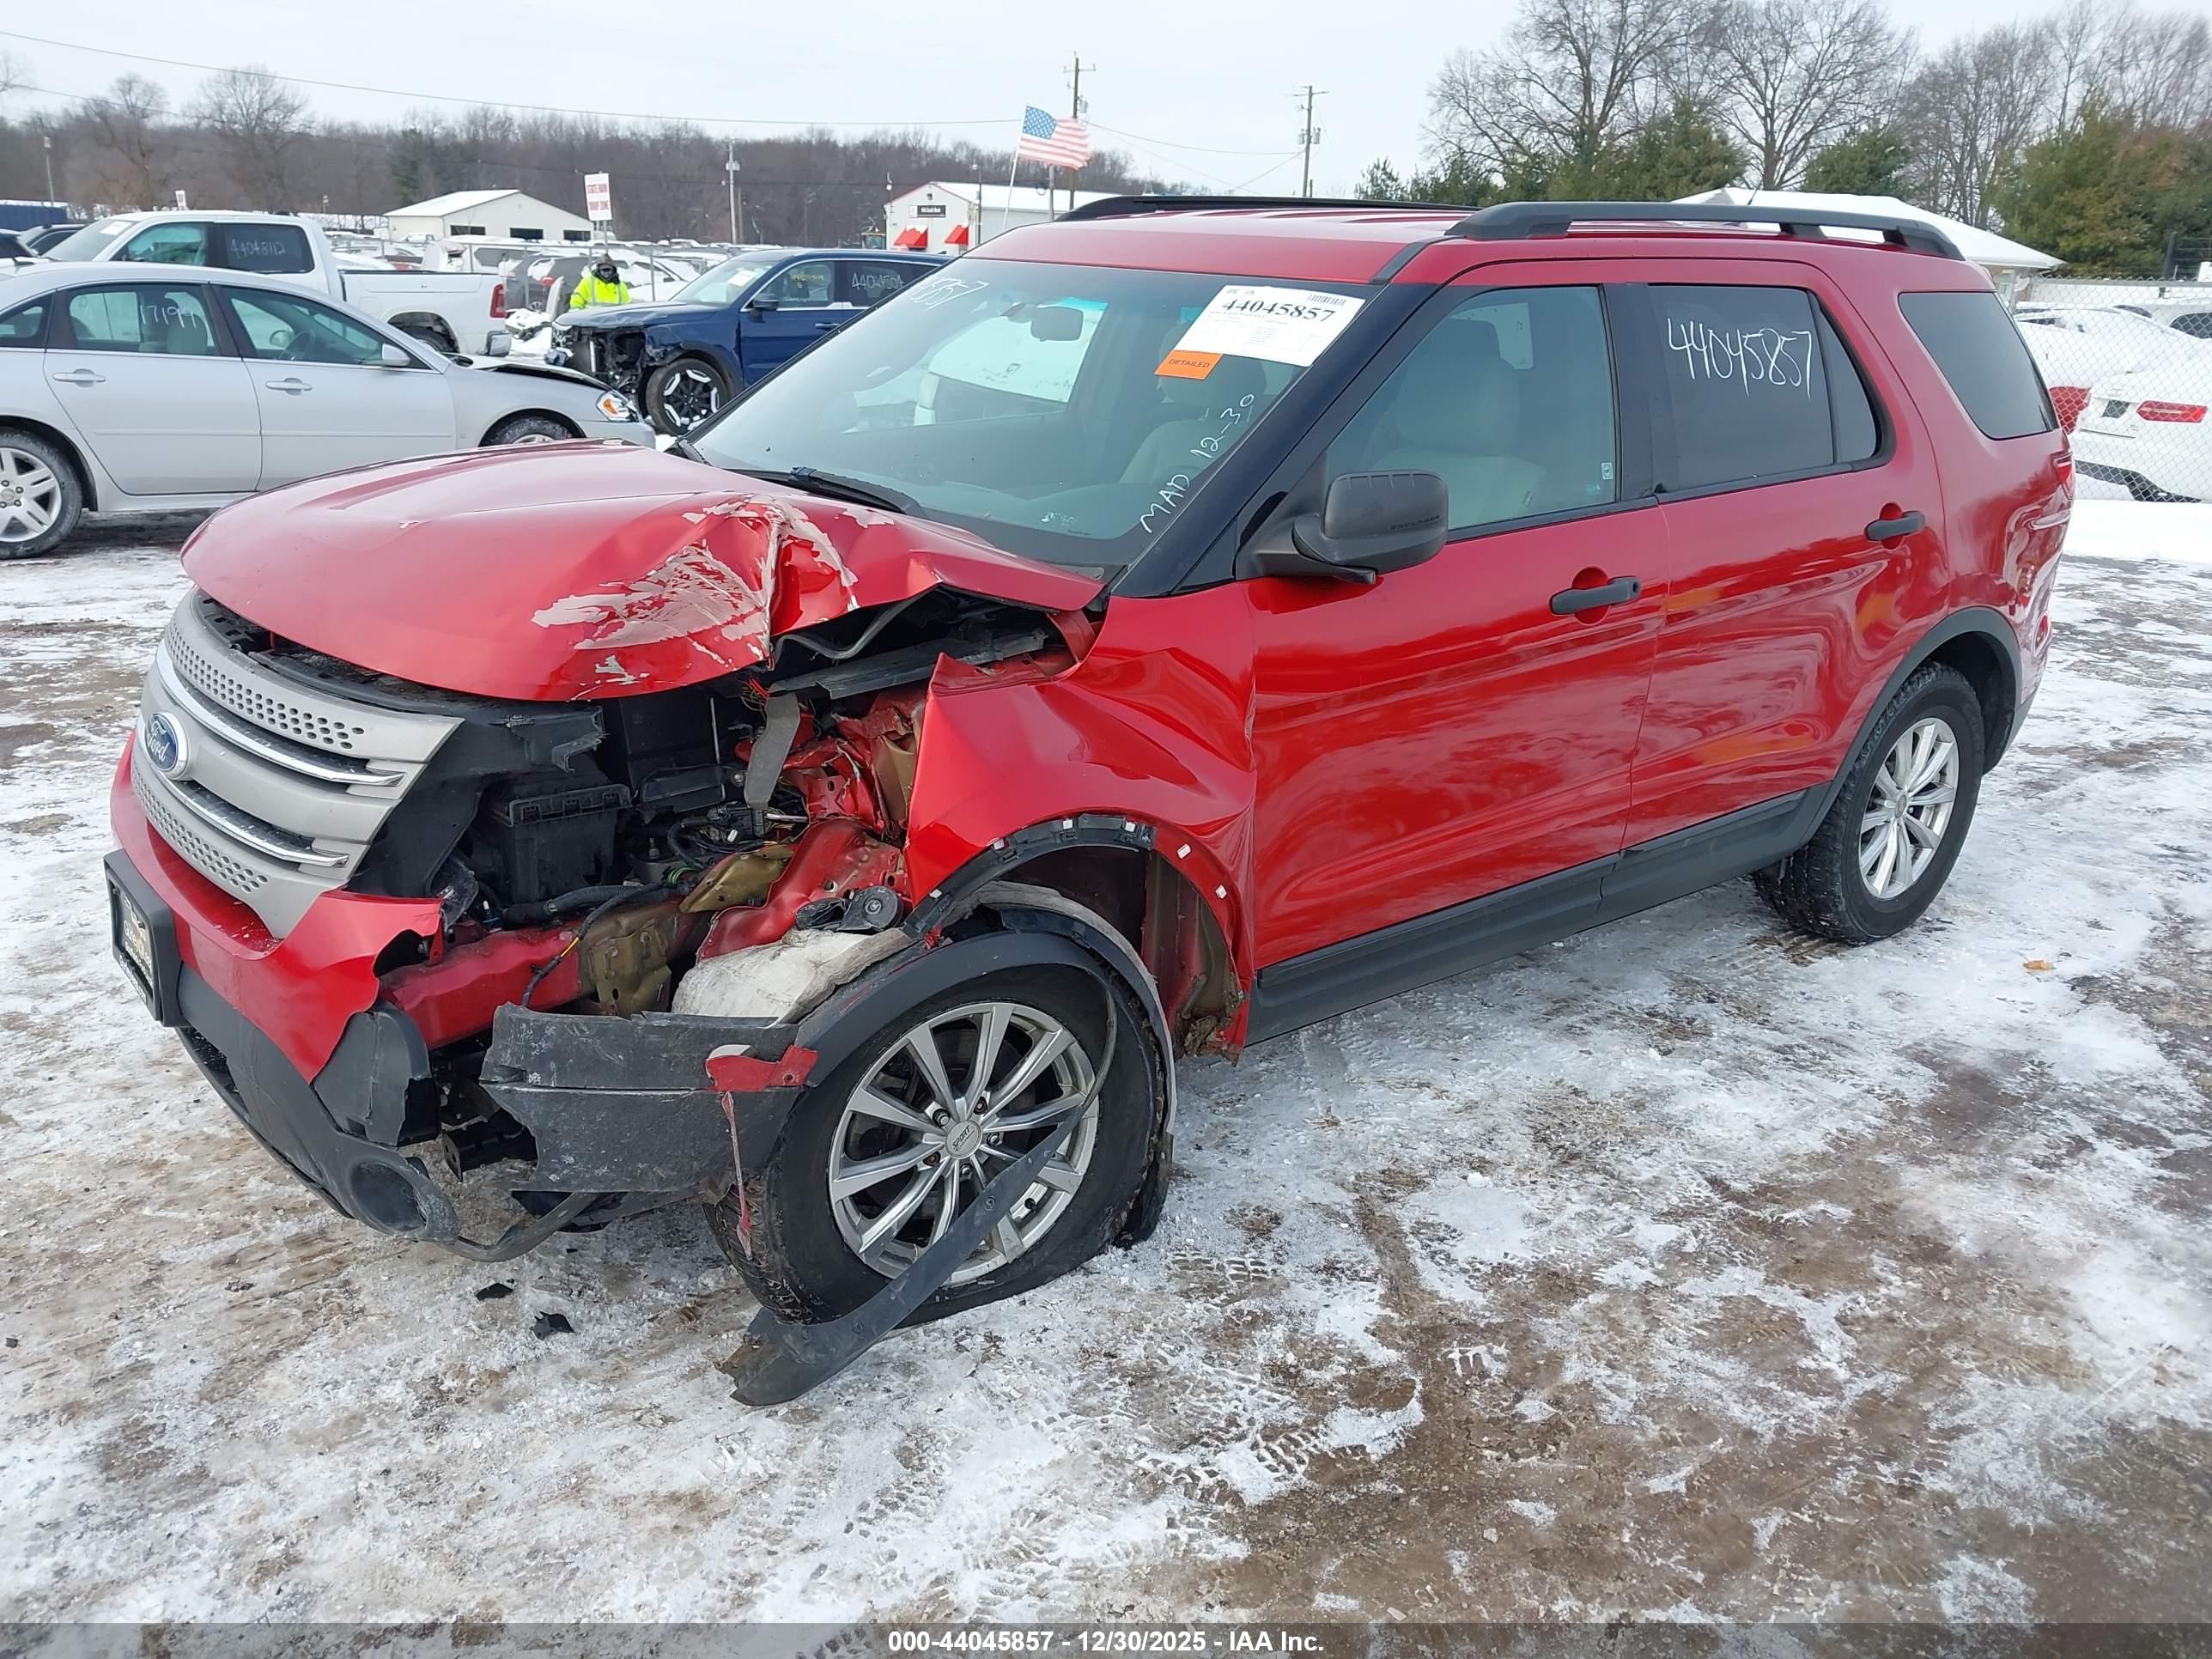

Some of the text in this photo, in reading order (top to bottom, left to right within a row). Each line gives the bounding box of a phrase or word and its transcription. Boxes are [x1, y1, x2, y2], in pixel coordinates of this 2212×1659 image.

[1222, 298, 1336, 323] 44045857
[1168, 358, 1211, 368] DETAILED
[1667, 317, 1812, 400] 44045857
[1139, 393, 1255, 534] MAD 12-30
[147, 720, 170, 763] Ford
